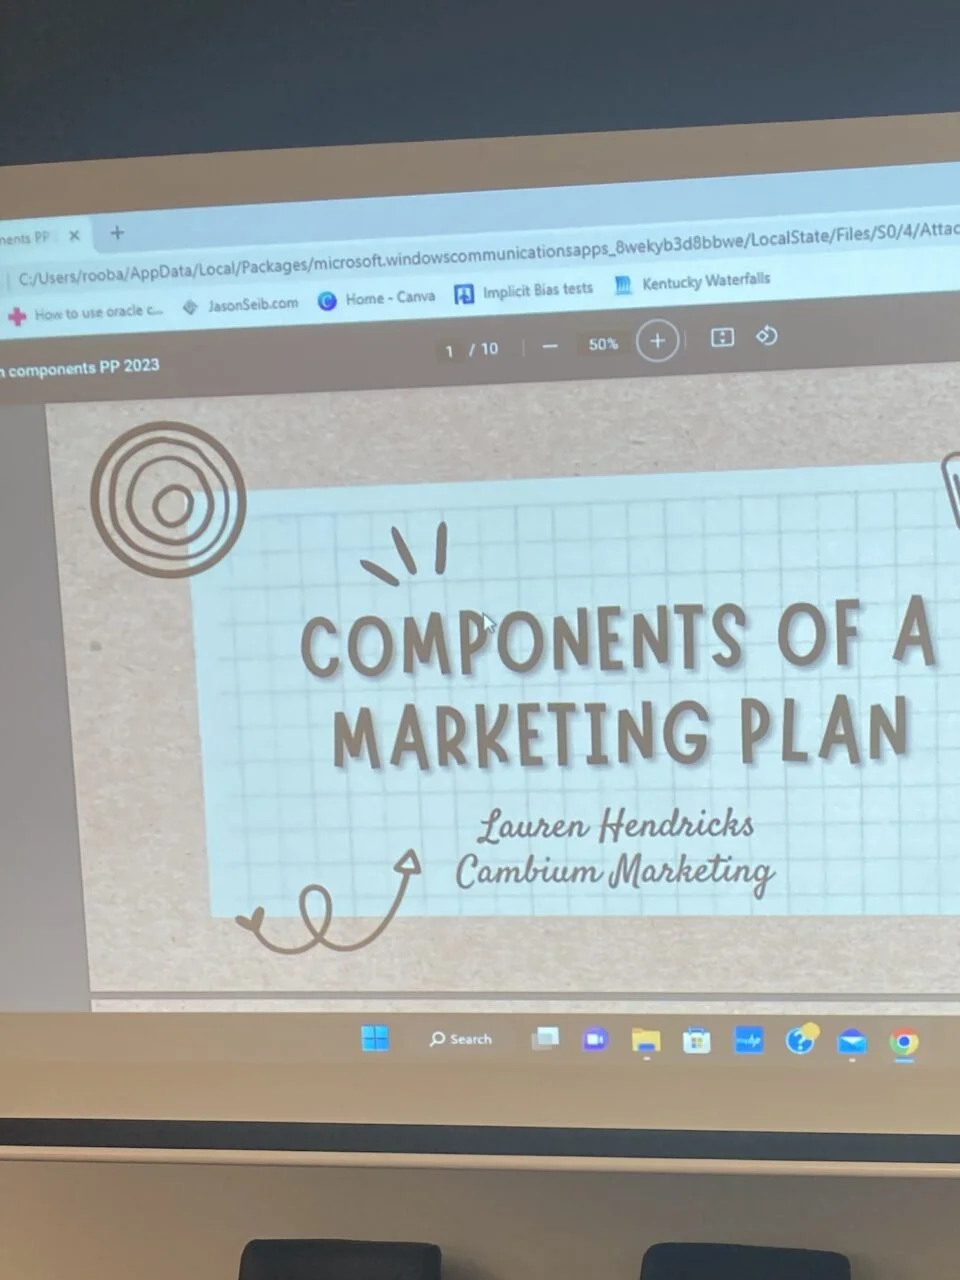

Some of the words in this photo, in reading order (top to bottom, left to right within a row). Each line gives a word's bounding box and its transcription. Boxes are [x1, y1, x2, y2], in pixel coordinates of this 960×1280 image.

[483, 283, 531, 300] Implicit
[534, 283, 560, 297] Bias
[563, 281, 594, 296] tests
[642, 276, 702, 293] Kentucky
[705, 272, 771, 288] Waterfalls
[208, 297, 299, 313] JasonSeib.com
[346, 292, 384, 306] Home
[396, 289, 436, 303] Canva
[35, 309, 63, 321] How
[66, 308, 79, 320] to
[82, 310, 104, 320] use
[106, 304, 143, 318] oracle
[445, 345, 453, 358] 1
[481, 342, 499, 355] 10
[588, 337, 620, 351] 50%
[8, 362, 97, 380] components
[99, 359, 120, 374] PP
[123, 358, 160, 373] 2023
[301, 603, 747, 678] COMPONENTS
[777, 598, 860, 668] OF
[892, 594, 936, 667] A
[333, 700, 709, 771] MARKETING
[740, 694, 907, 764] PLAN
[476, 807, 591, 846] Lauren
[598, 807, 755, 843] Hendricks
[455, 853, 605, 890] Cambium
[607, 855, 776, 900] Marketing
[450, 1032, 493, 1047] Search
